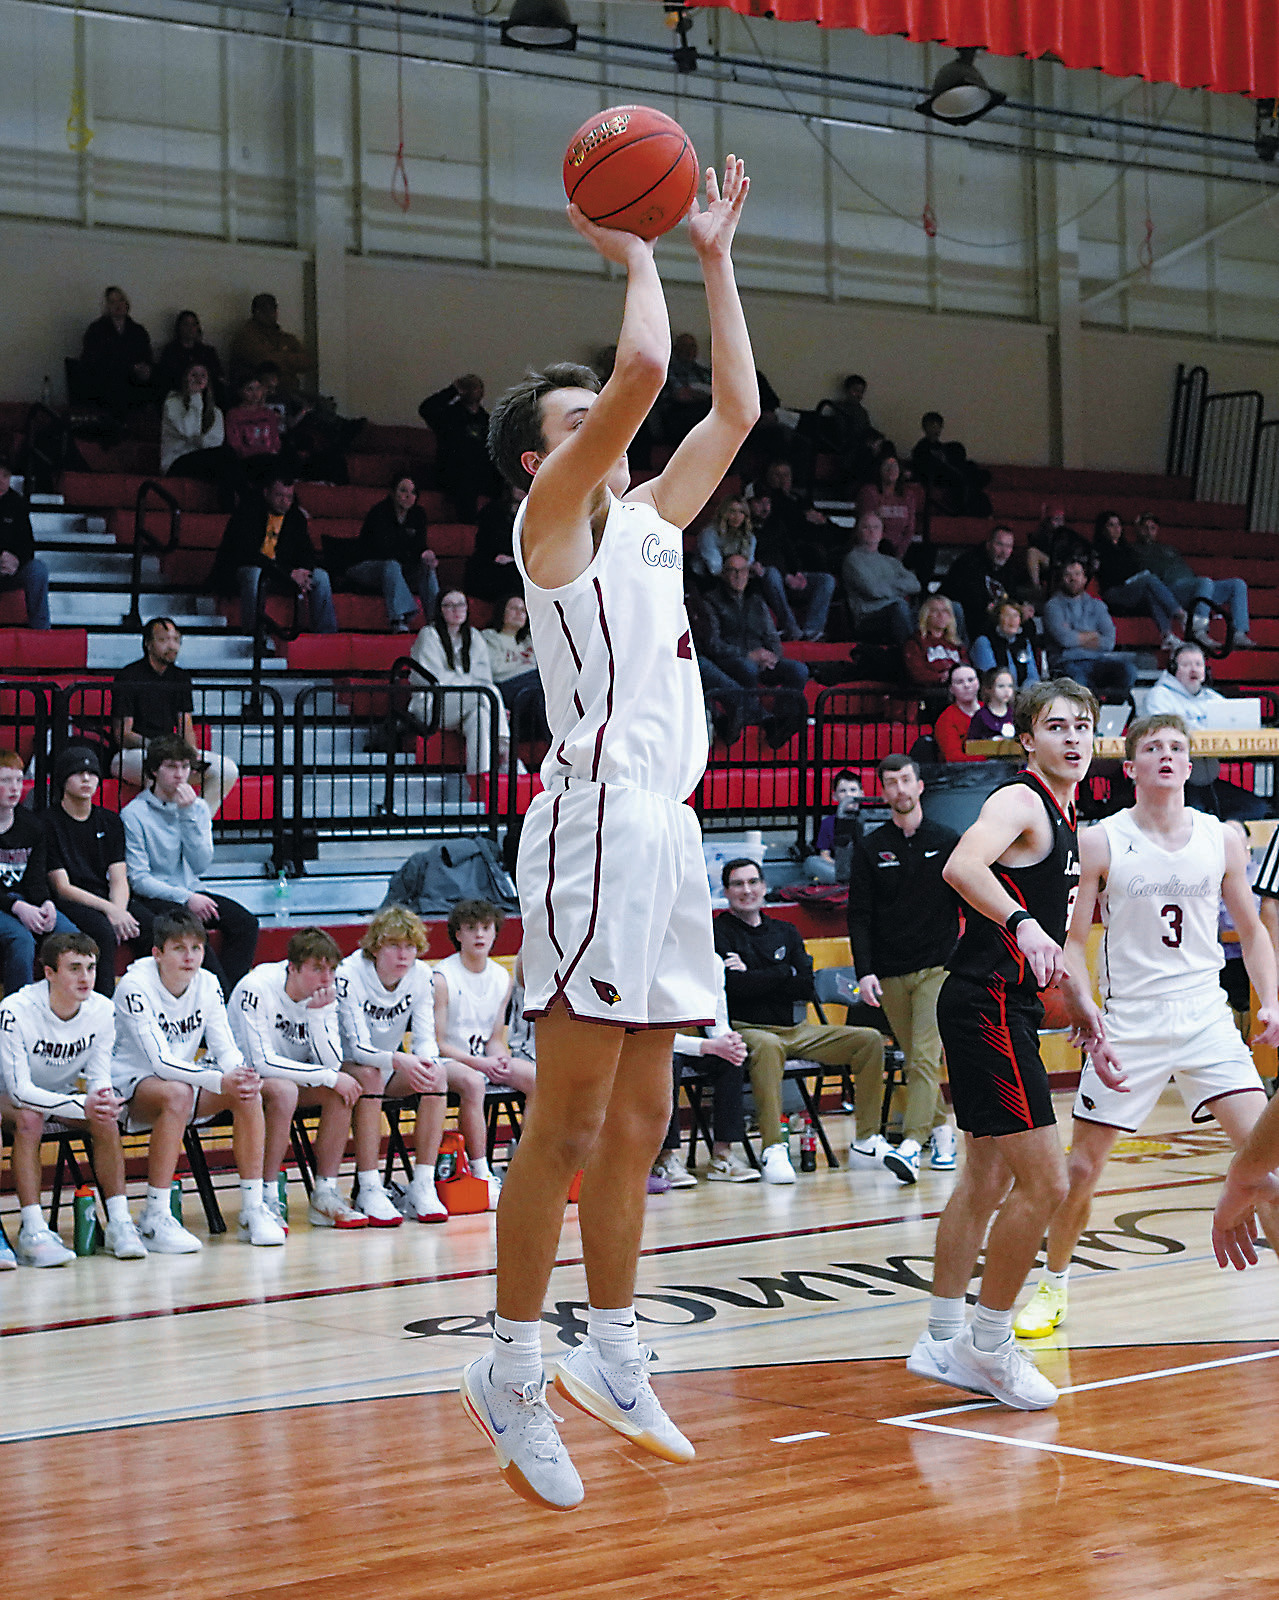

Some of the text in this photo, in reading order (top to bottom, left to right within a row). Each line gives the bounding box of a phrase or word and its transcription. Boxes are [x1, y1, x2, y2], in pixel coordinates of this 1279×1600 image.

[1239, 738, 1278, 752] HIGH
[1127, 874, 1212, 898] Cardinals
[1160, 903, 1184, 948] 3
[125, 992, 145, 1015] 15
[241, 990, 259, 1012] 24
[0, 1009, 16, 1033] 12
